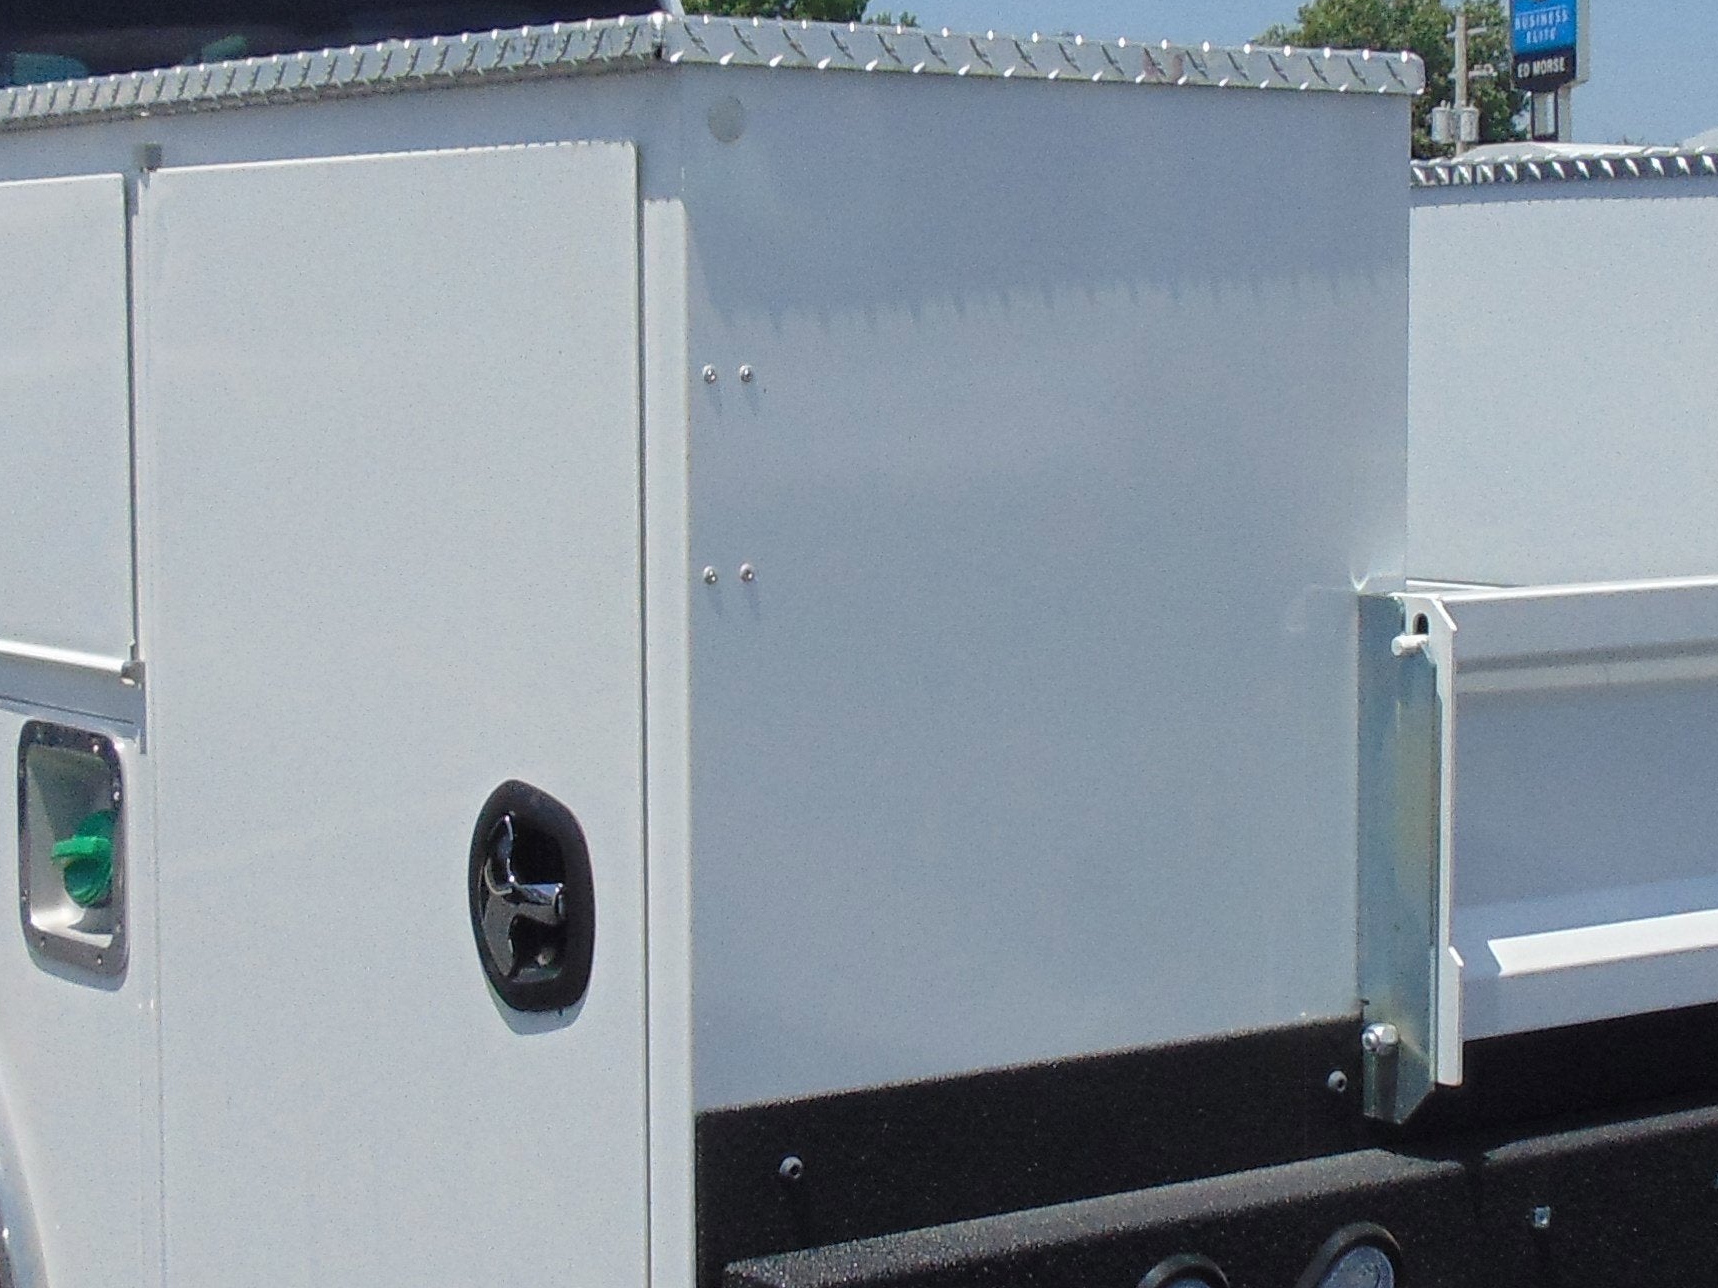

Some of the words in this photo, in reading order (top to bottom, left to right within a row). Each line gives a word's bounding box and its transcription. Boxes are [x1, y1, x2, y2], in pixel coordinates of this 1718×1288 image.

[1515, 10, 1568, 30] BUSINESS
[1518, 62, 1530, 78] ED
[1534, 57, 1566, 76] MORSE
